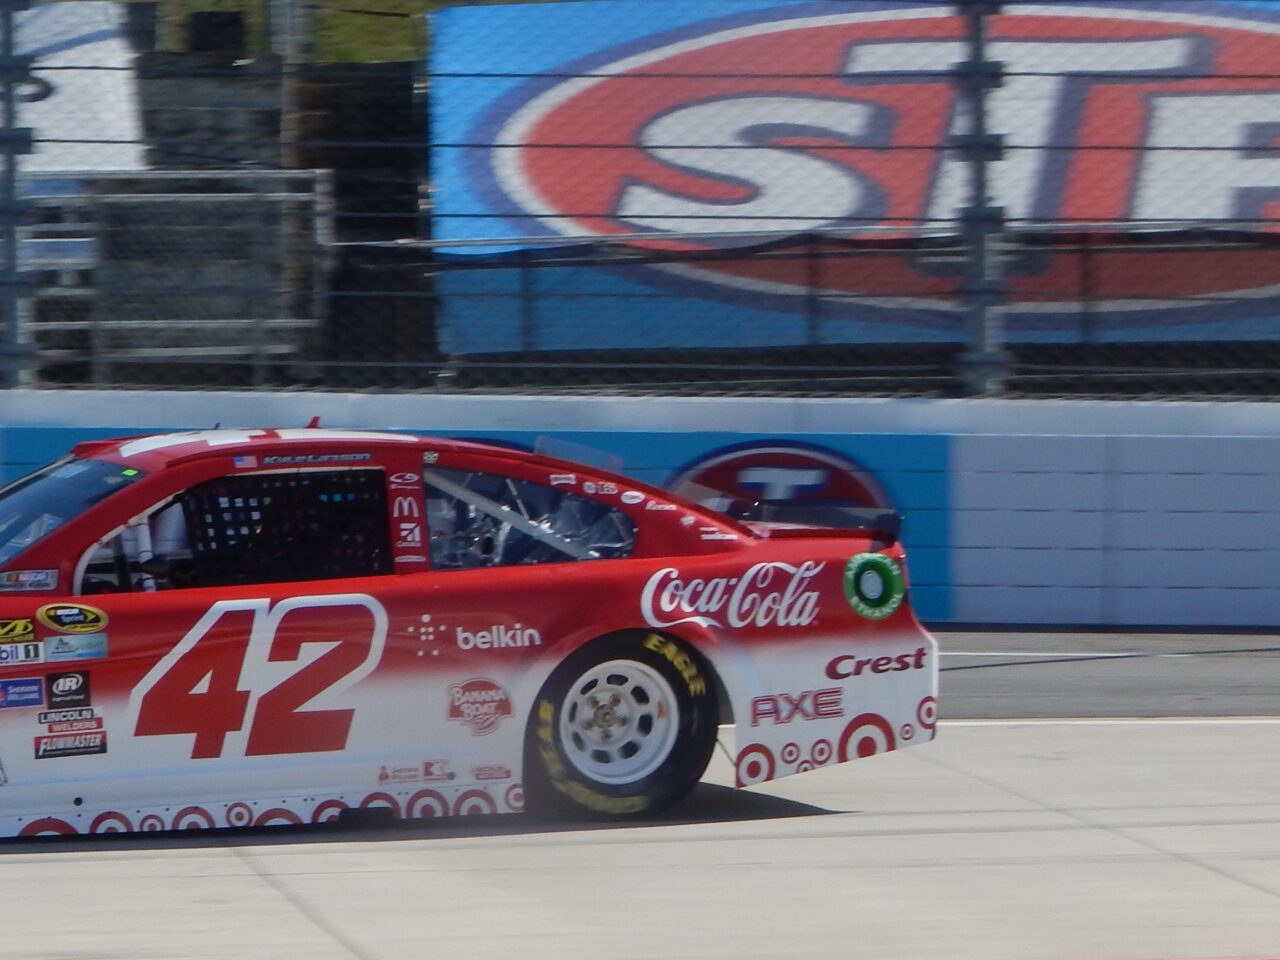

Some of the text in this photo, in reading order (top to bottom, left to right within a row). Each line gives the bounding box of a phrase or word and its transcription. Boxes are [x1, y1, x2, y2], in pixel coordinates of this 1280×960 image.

[640, 561, 826, 628] Coca-Cola
[25, 644, 38, 659] 1
[456, 623, 542, 650] belkin
[129, 593, 389, 759] 42
[644, 633, 707, 697] EAGLE
[826, 648, 927, 680] Crest
[41, 710, 92, 722] LINCOLN
[750, 687, 844, 728] AXE
[39, 734, 102, 756] FLOWMASTER
